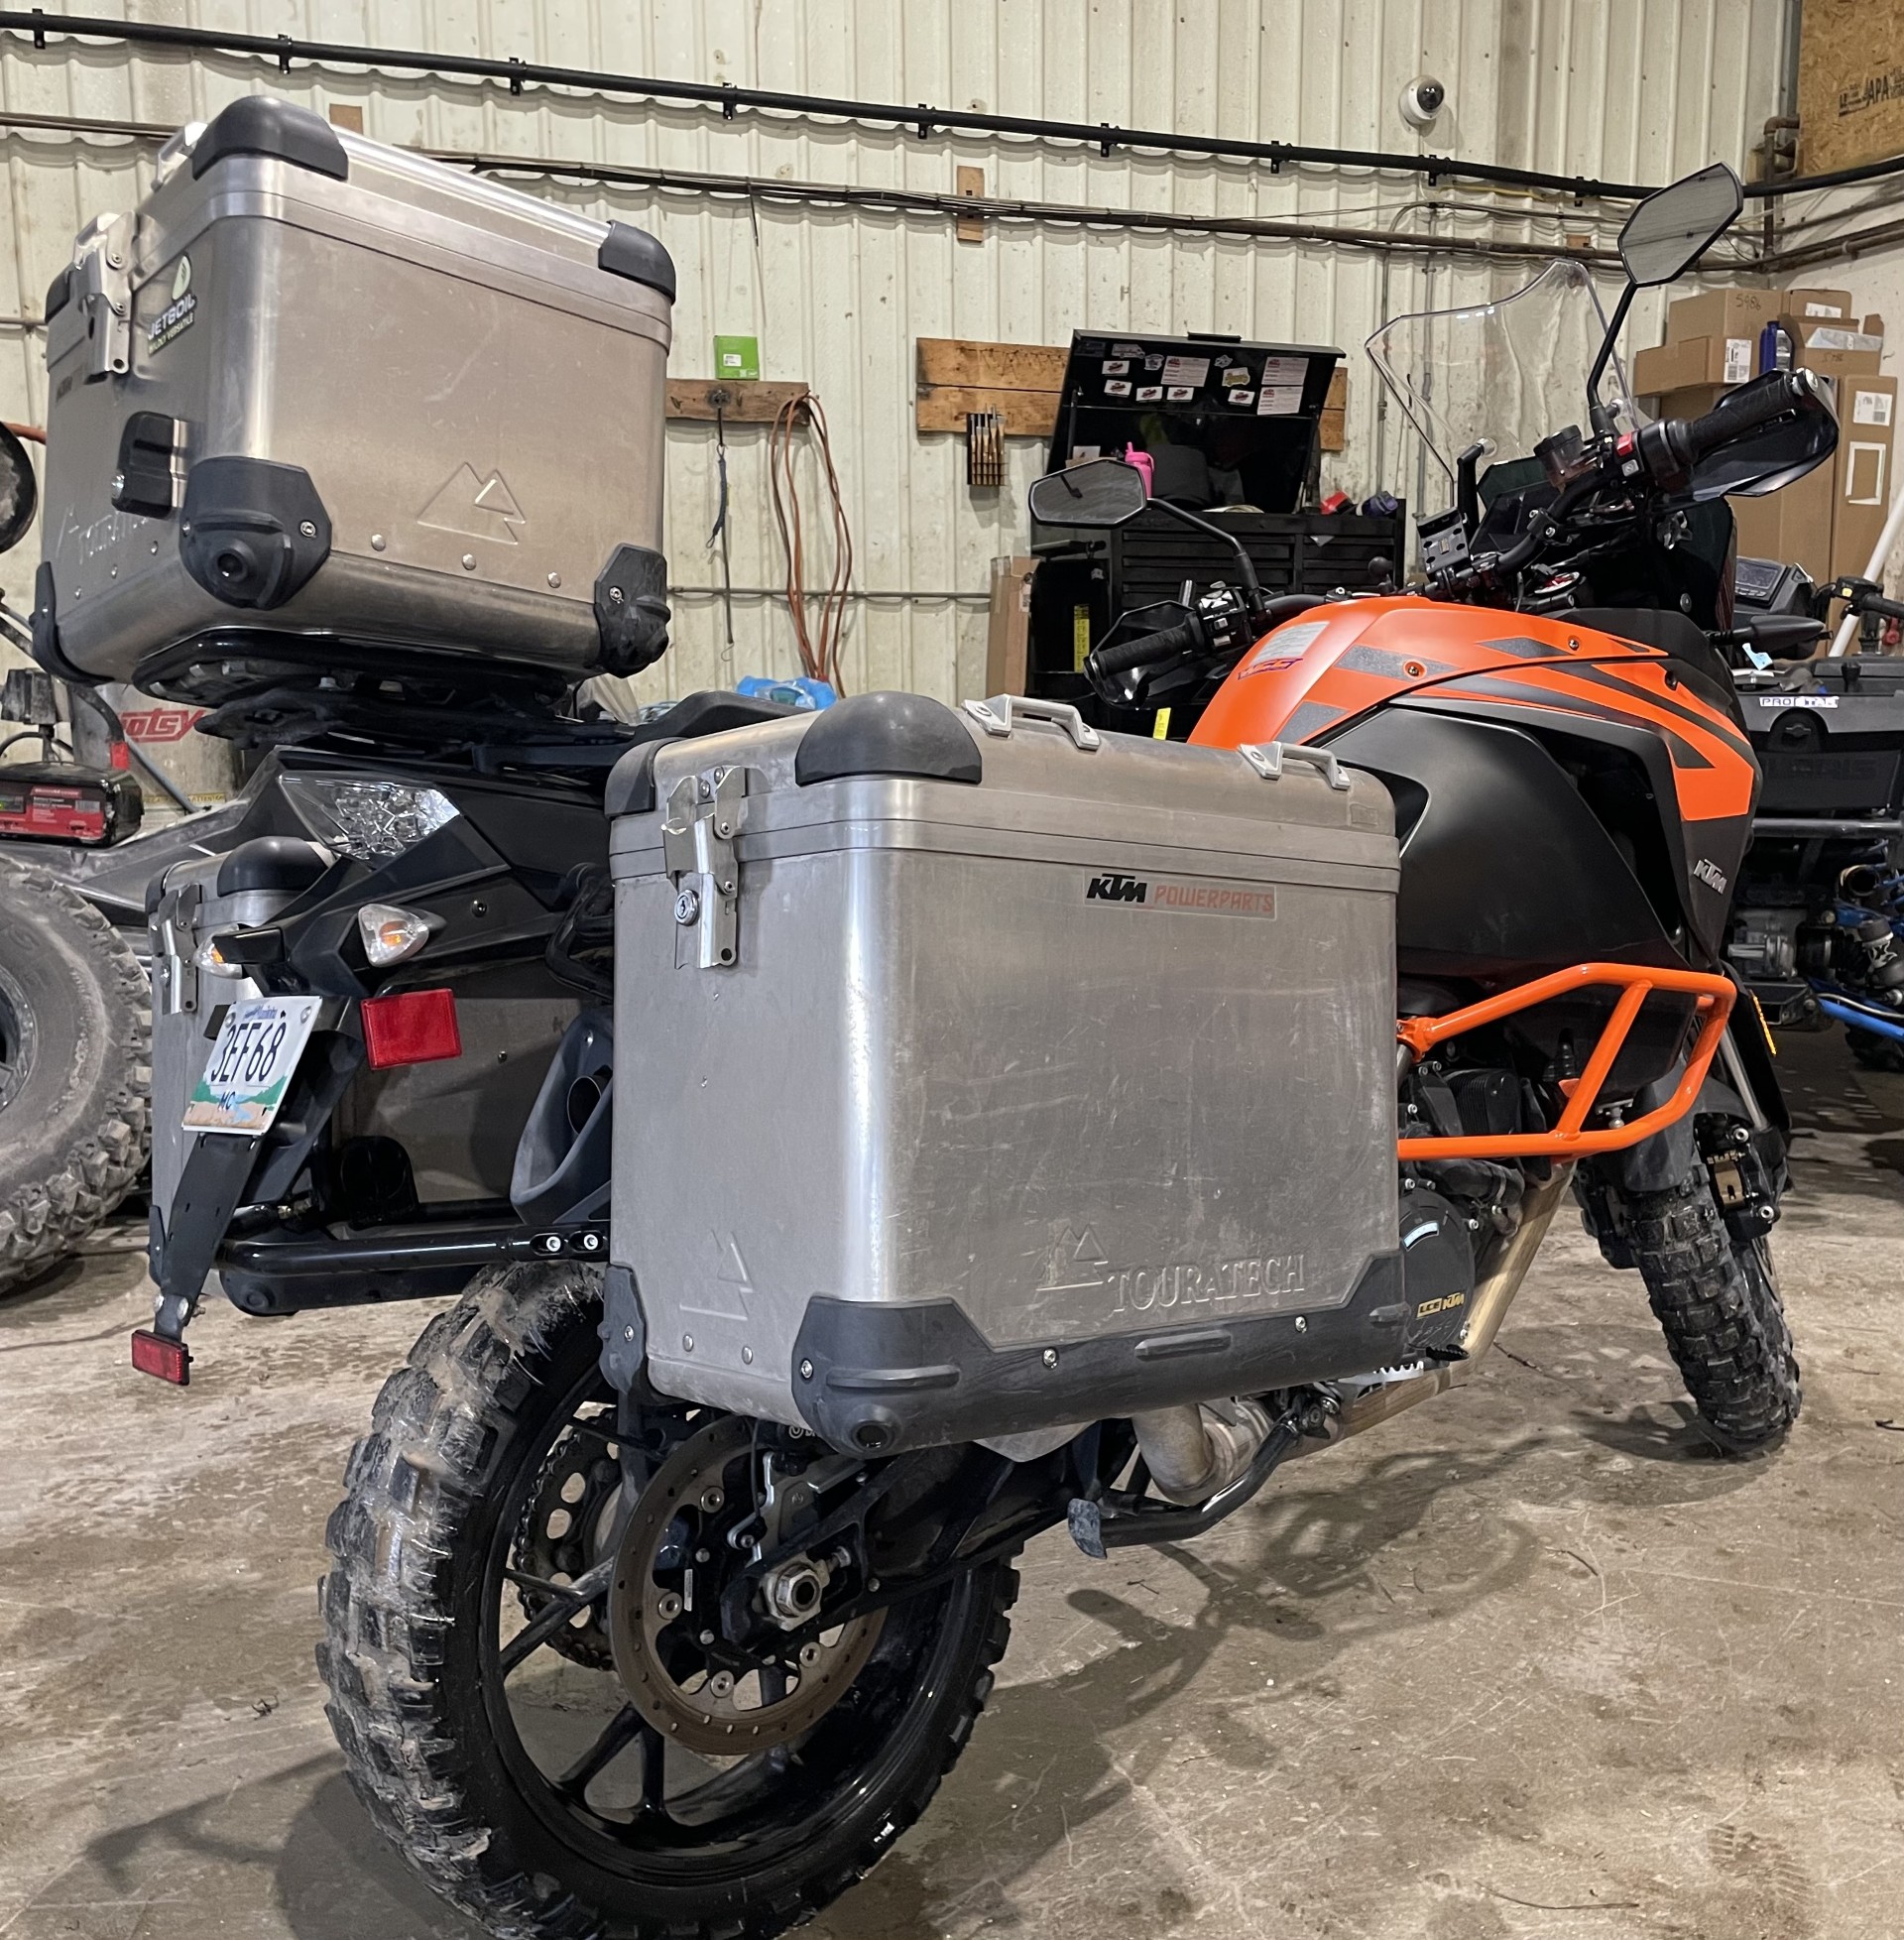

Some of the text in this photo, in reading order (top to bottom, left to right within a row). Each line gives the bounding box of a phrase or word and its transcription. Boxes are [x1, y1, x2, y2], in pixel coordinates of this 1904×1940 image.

[147, 293, 196, 341] JETBOIL
[1761, 697, 1792, 707] PRO
[1087, 873, 1273, 912] KTM POWERPARTS
[1694, 859, 1726, 894] KTM
[210, 1022, 287, 1082] 3EF68
[218, 1091, 236, 1111] MC
[1107, 1254, 1305, 1312] TOURATECH
[1442, 1292, 1465, 1310] KTM
